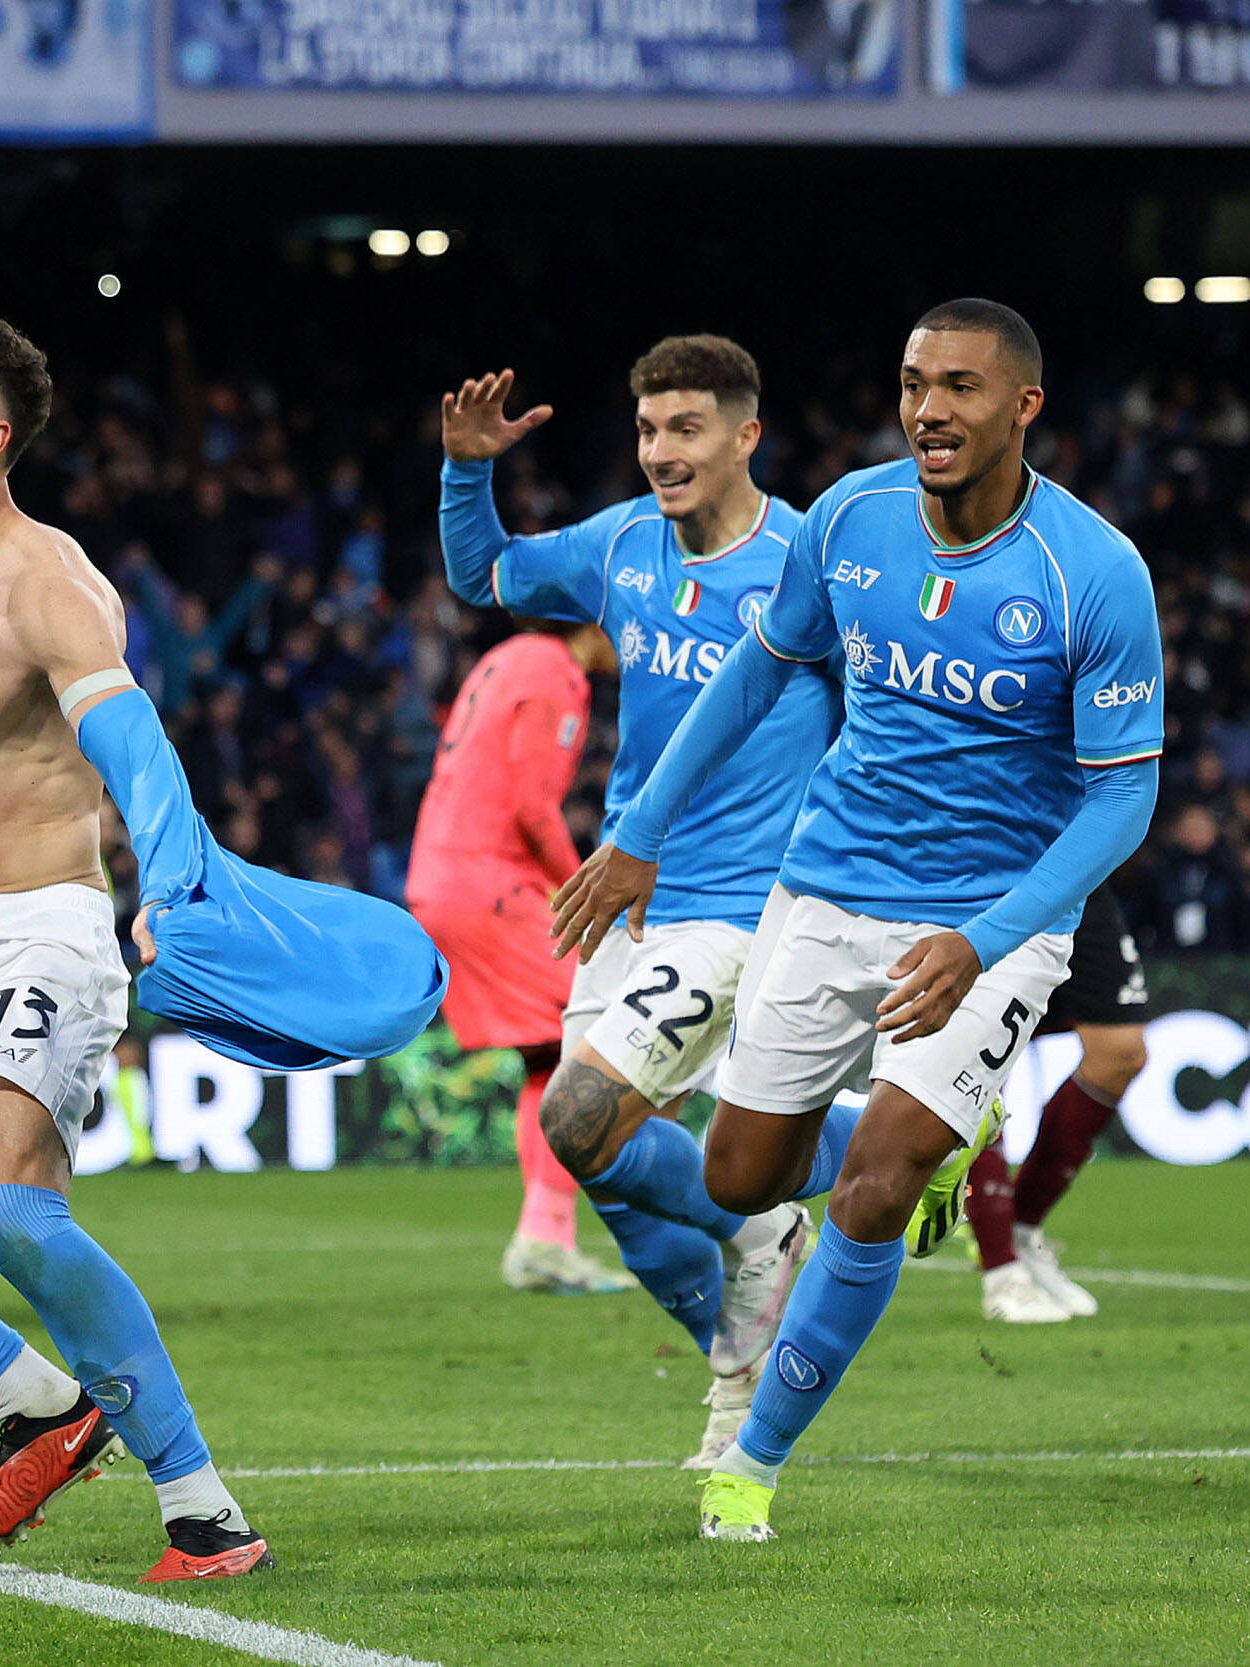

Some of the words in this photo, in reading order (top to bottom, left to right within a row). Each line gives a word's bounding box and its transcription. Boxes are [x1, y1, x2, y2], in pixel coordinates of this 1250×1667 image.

[834, 560, 881, 590] EA7
[647, 631, 726, 684] MS
[883, 640, 1027, 712] MSC
[1093, 676, 1157, 709] ebay
[622, 965, 714, 1051] 22
[979, 997, 1030, 1070] 5
[626, 1027, 669, 1066] EA7
